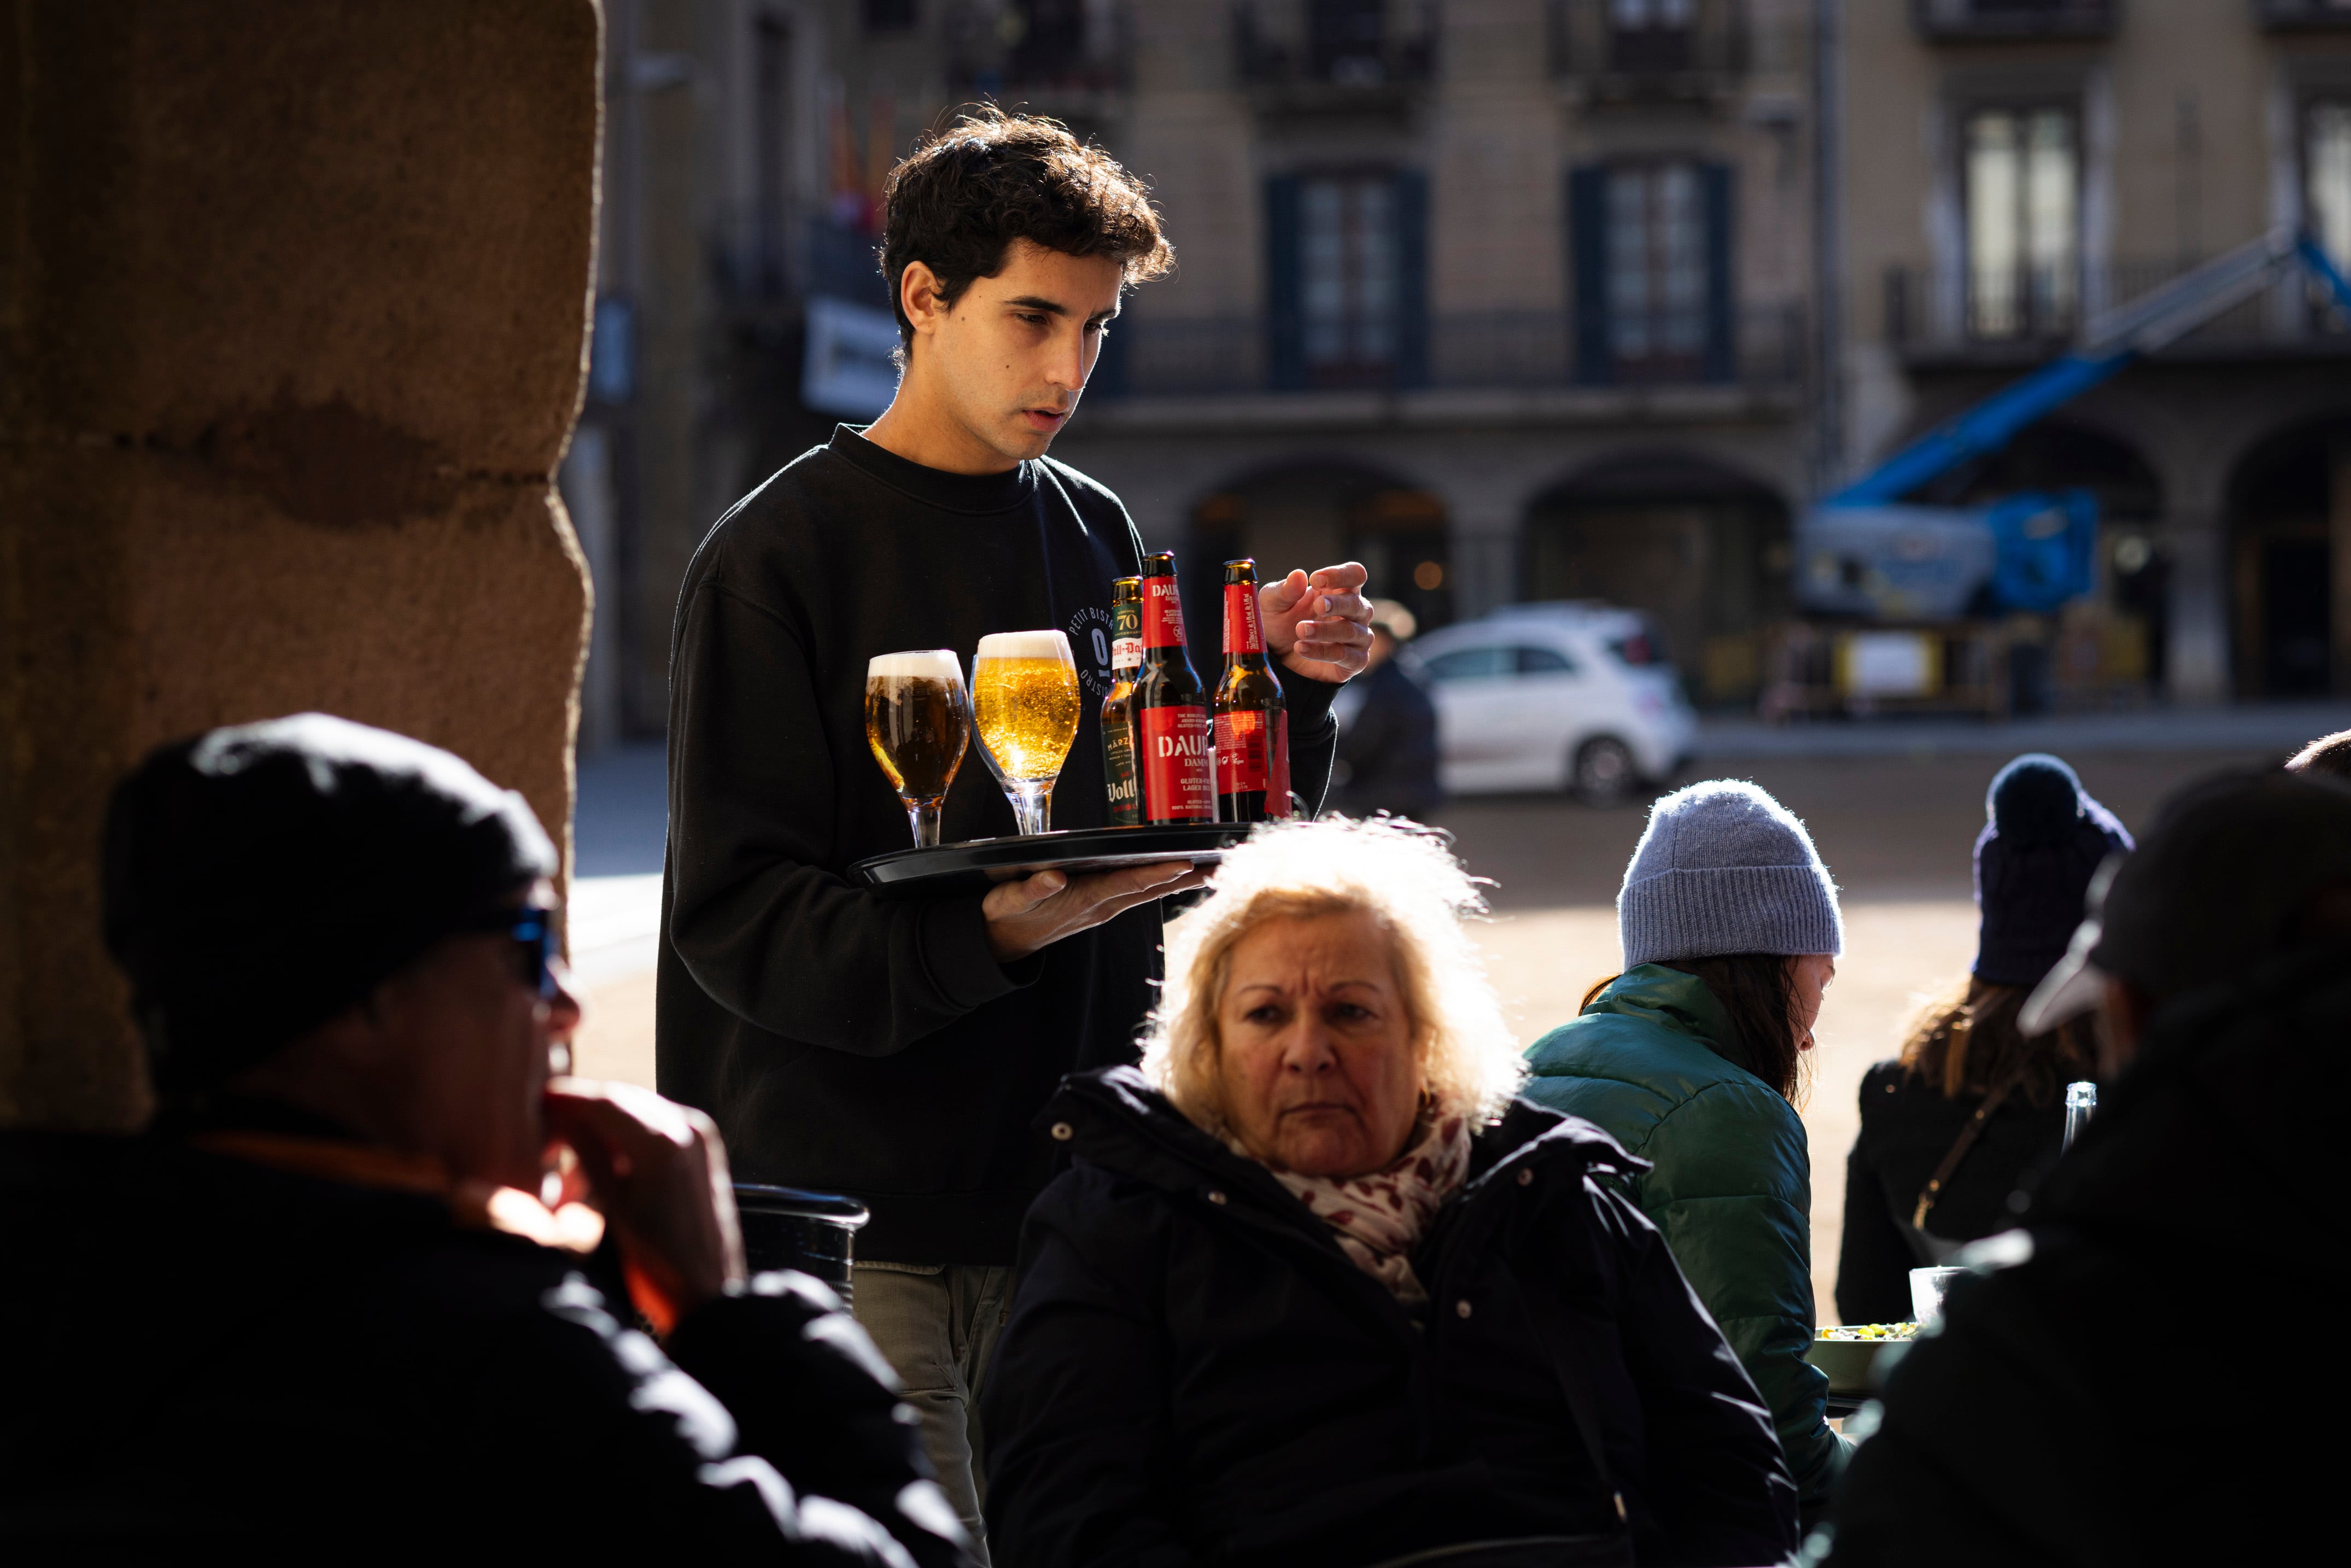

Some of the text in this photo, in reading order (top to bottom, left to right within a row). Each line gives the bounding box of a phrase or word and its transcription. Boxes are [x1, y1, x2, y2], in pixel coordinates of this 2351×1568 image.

[1069, 607, 1114, 636] PETIT BISTR
[1117, 615, 1138, 630] 70
[1158, 735, 1208, 757] DAUR
[1107, 779, 1135, 803] Voll
